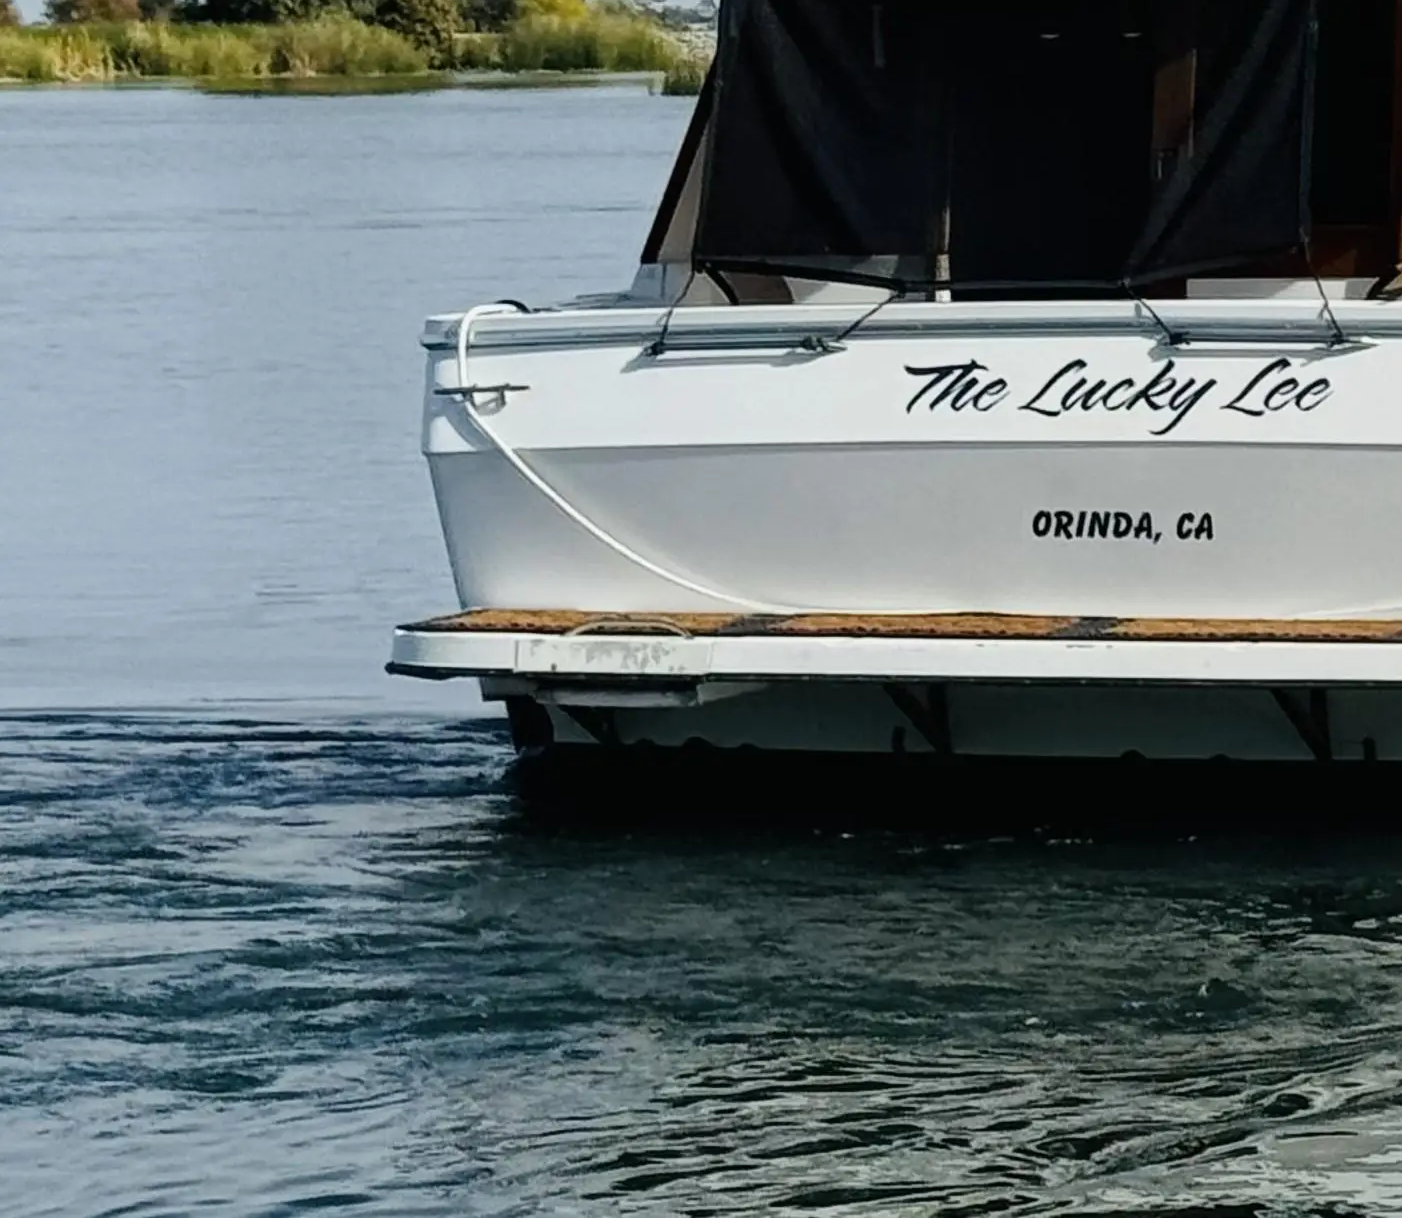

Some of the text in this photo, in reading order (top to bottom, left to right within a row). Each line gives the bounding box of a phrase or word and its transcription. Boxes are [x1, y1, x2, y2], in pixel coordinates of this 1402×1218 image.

[904, 358, 1335, 435] The Lucky Lee
[1032, 510, 1214, 544] ORINDA, CA
